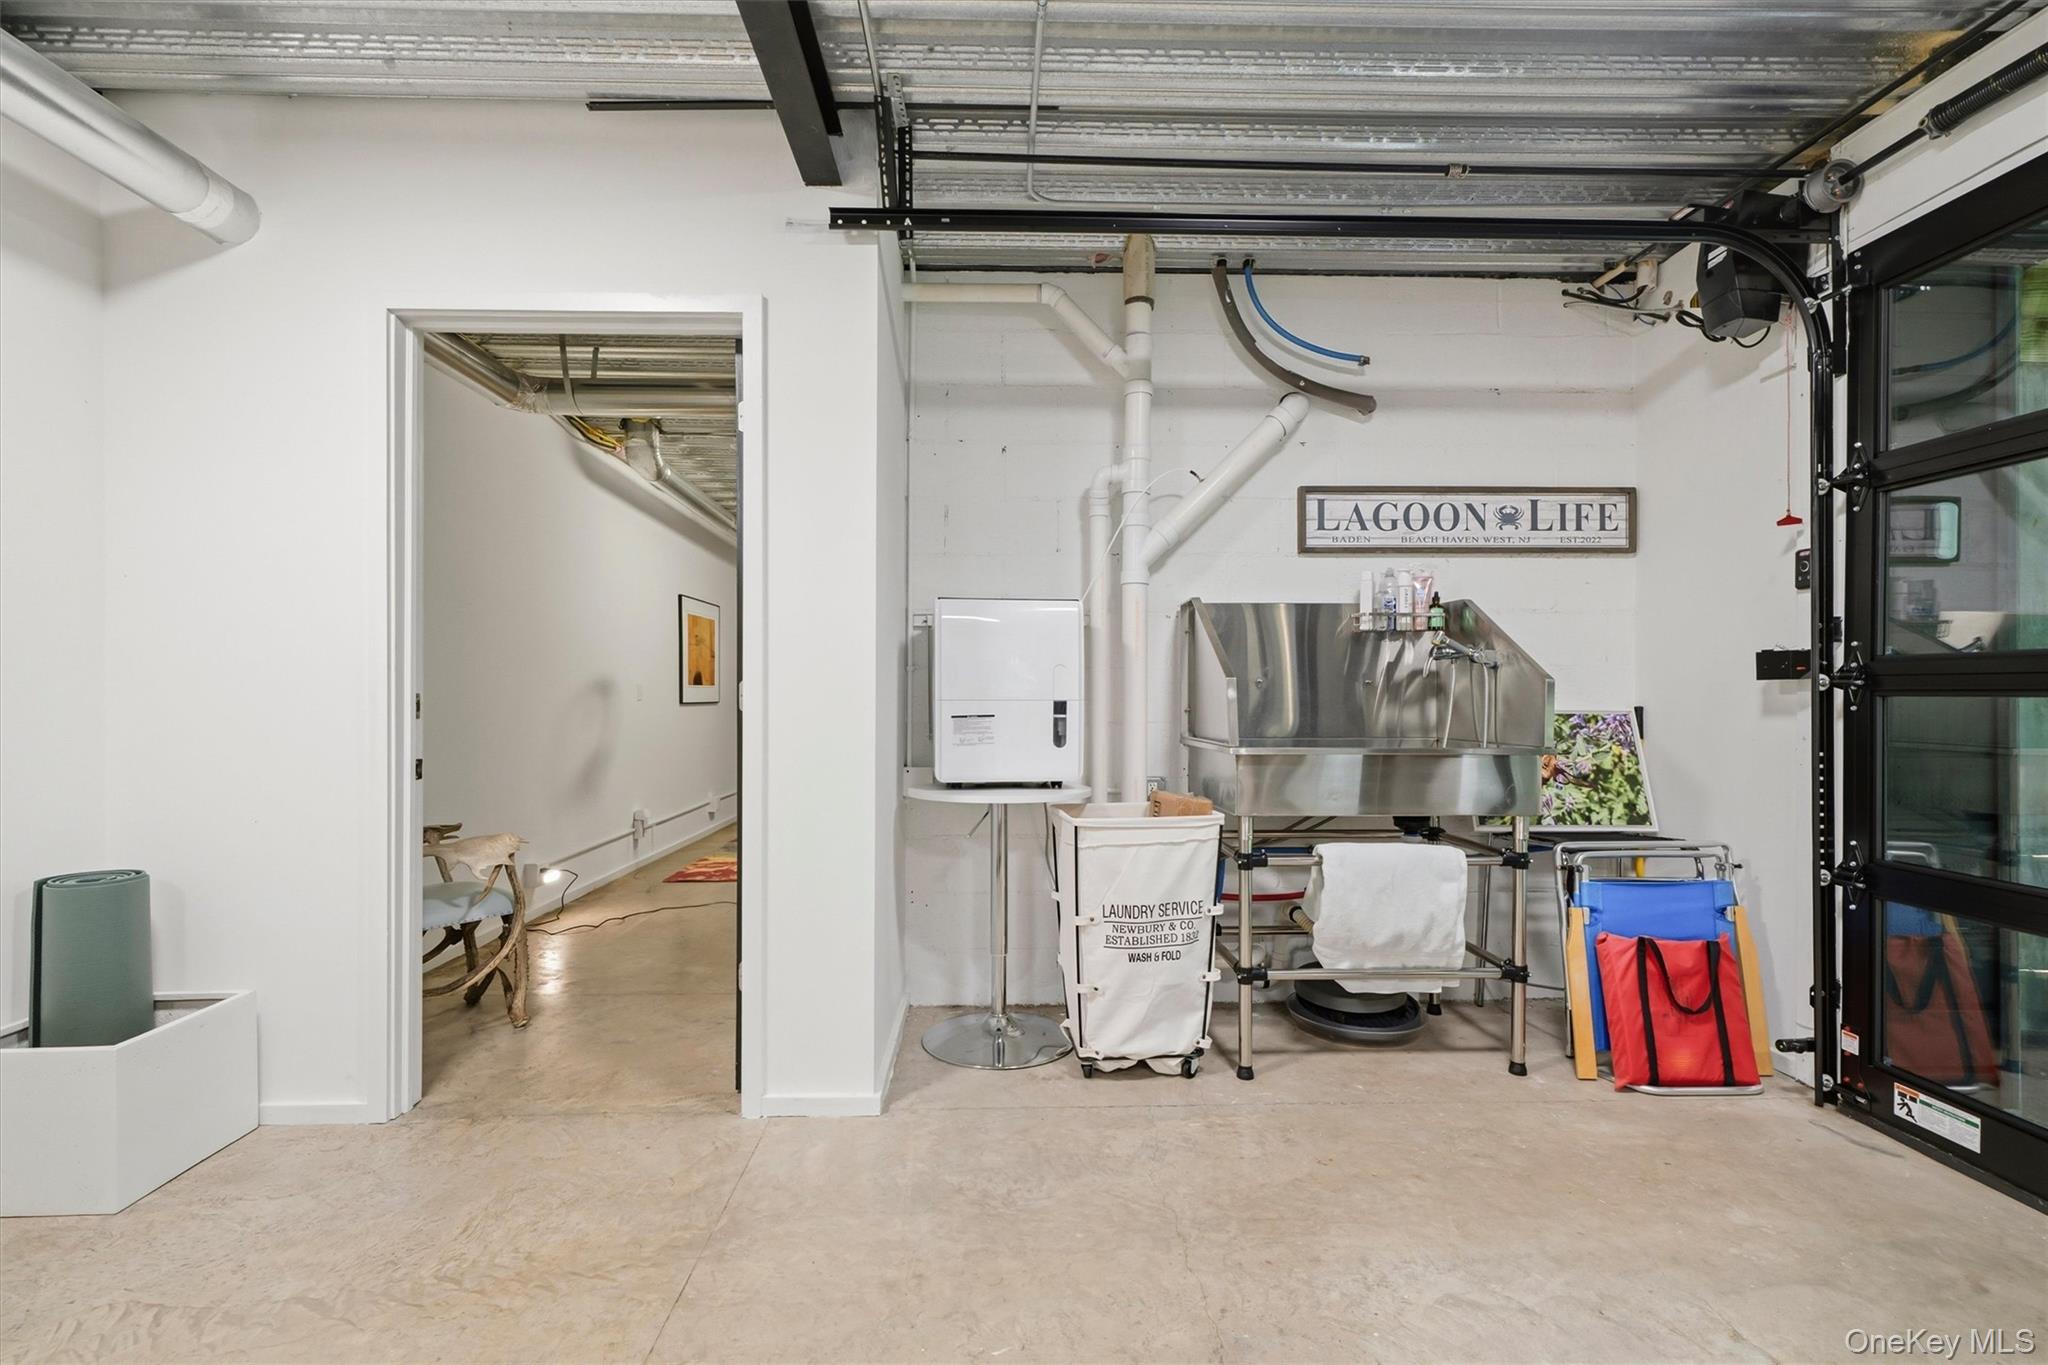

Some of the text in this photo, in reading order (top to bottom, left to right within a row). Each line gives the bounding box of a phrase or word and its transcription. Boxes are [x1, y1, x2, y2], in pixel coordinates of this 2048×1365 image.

[1316, 498, 1619, 532] LAGOON LIFE
[1331, 536, 1371, 544] BADEN
[1400, 536, 1531, 545] BEACH HAVEN WEST, NJ
[1102, 900, 1204, 919] LAUNDRY SERVICE
[1112, 920, 1196, 934] NEWBURY & CO.
[1105, 933, 1178, 946] ESTABLISHED
[1128, 950, 1181, 962] WASH & FOLD
